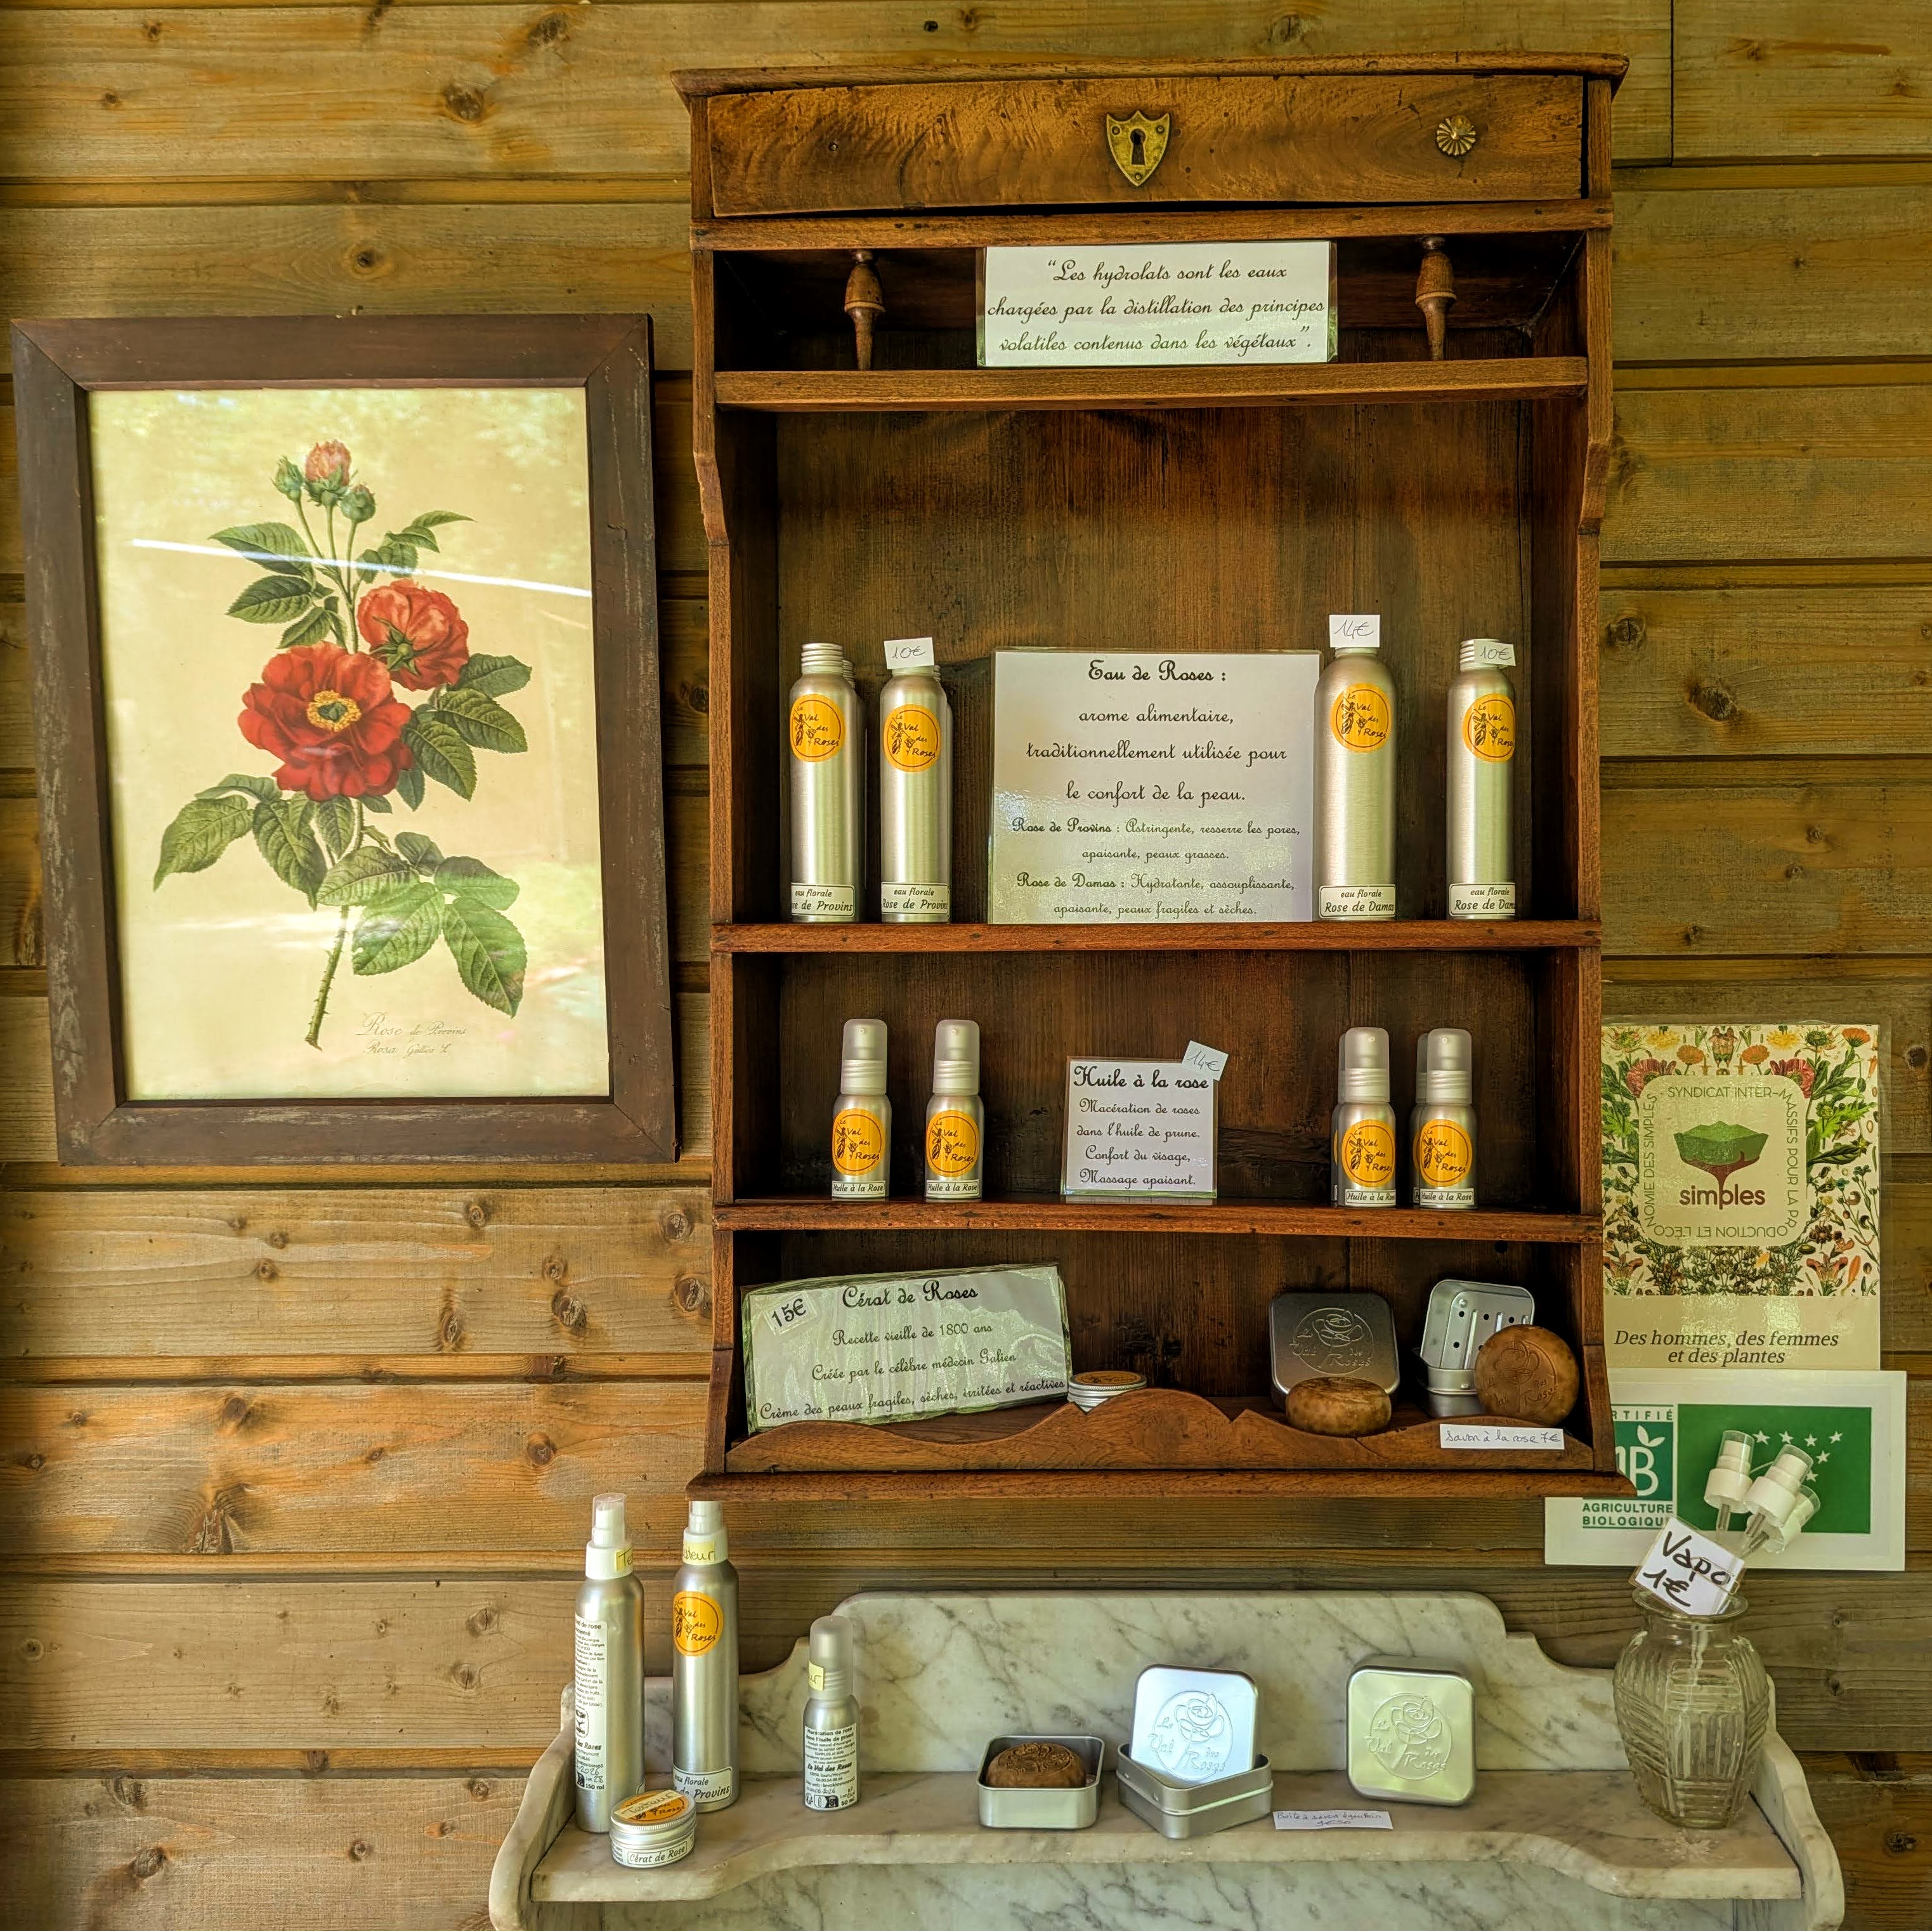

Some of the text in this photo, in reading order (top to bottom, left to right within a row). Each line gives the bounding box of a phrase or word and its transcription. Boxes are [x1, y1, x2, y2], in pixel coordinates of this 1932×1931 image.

[1092, 261, 1170, 288] hydrolats
[1177, 265, 1212, 280] sont
[1219, 259, 1241, 279] les
[1247, 268, 1286, 278] eaux
[988, 296, 1324, 323] chargées par la distillation des principes
[999, 331, 1067, 351] volatiles
[1074, 335, 1143, 350] contenus
[1151, 334, 1189, 349] dans
[1195, 331, 1217, 348] les
[1334, 619, 1374, 639] 14€
[892, 646, 925, 659] 10€
[1479, 645, 1511, 660] 10€
[1088, 659, 1214, 681] Eau de Roses
[1079, 704, 1234, 725] arome alimentaire,
[904, 723, 919, 731] Val
[912, 748, 936, 758] Roses
[1026, 740, 1287, 768] traditionnellement utilisée pour
[1066, 781, 1245, 808] le confort de la peau.
[1012, 817, 1300, 839] Rose de Provins Astringente, resserre les pores,
[1081, 849, 1229, 864] apaisante, peaux grasses.
[909, 887, 934, 896] florale
[1017, 872, 1294, 894] Rose de Damas Hydratante, assouplissante,
[883, 898, 915, 908] Rose de
[1340, 889, 1381, 898] eau florale
[1054, 901, 1256, 919] apaisante, peaux fragiles et sèches.
[1325, 901, 1394, 913] Rose de Damas
[355, 1012, 402, 1035] Rose
[1187, 1051, 1220, 1071] 14€
[1073, 1066, 1209, 1088] Huile à la rose
[1668, 1087, 1730, 1097] SYNDICAT
[1080, 1098, 1200, 1115] Macération de roses
[1643, 1093, 1657, 1148] SIMPLES
[1076, 1122, 1200, 1142] dans l'huile de prune.
[1085, 1145, 1190, 1166] Confort du visage,
[1644, 1152, 1654, 1177] DES
[1787, 1148, 1798, 1185] POUR
[1080, 1168, 1196, 1189] Massage apaisant.
[1680, 1184, 1765, 1210] simples
[1787, 1189, 1798, 1205] LA
[1698, 1226, 1711, 1237] ET
[842, 1280, 978, 1307] Cérat de Roses
[771, 1298, 807, 1329] 15€
[833, 1323, 992, 1347] Recette vieille de 1800 ans
[1614, 1330, 1839, 1347] Des hommes, des femmes
[812, 1348, 1016, 1384] Créée par le célèbre médecin Galien
[1668, 1349, 1785, 1367] et des plantes
[760, 1379, 1066, 1419] Crème des peaux fragiles, sèches, irritées et réactives
[1612, 1410, 1673, 1420] RTIFIÉ
[1484, 1431, 1490, 1441] à
[1495, 1430, 1510, 1441] la
[1541, 1432, 1560, 1443] 7€
[1583, 1503, 1673, 1513] AGRICULTURE
[1583, 1516, 1662, 1526] BIOLOGIQU
[1643, 1569, 1691, 1607] 1€
[684, 1777, 708, 1785] florale
[694, 1786, 729, 1798] Provins
[630, 1854, 653, 1862] Cérat
[668, 1846, 685, 1858] Rose
